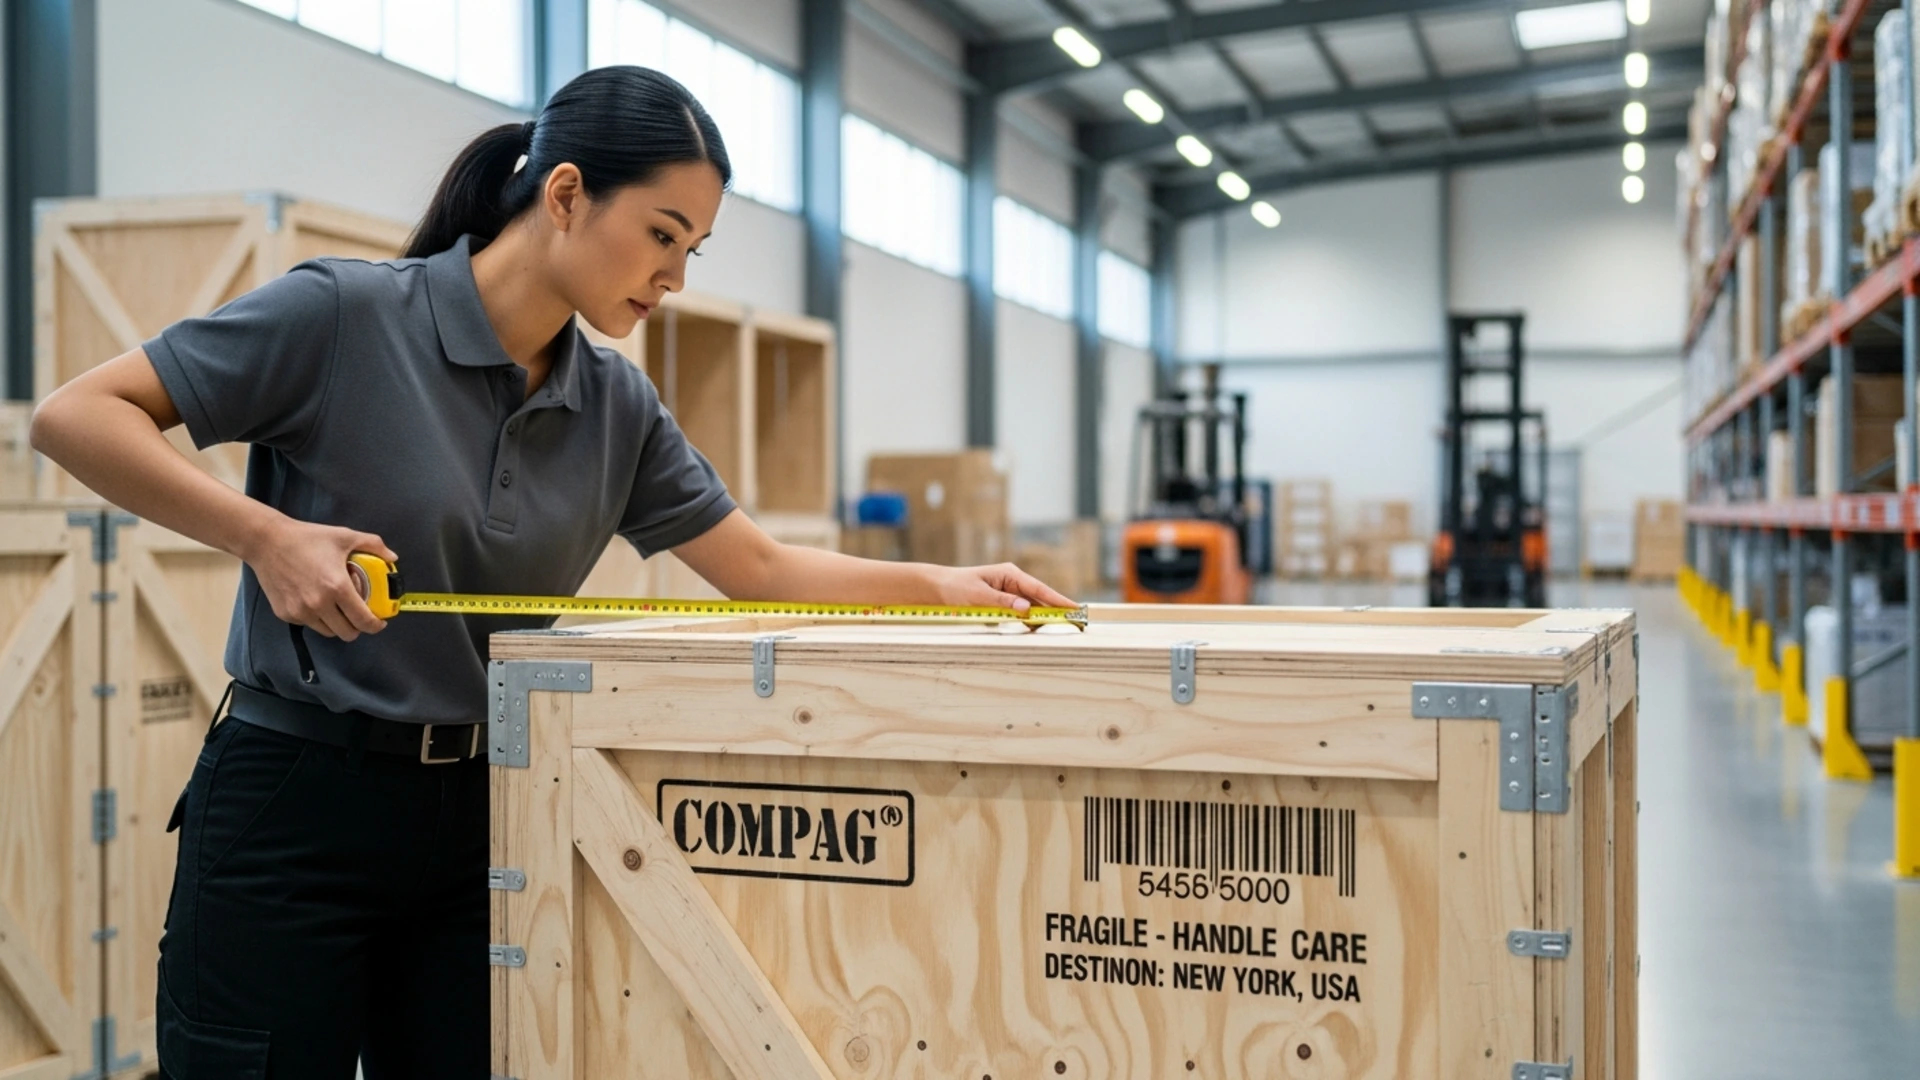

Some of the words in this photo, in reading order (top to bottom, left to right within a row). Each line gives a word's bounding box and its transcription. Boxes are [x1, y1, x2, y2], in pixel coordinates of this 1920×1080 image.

[1045, 912, 1148, 948] FRAGILE
[1173, 921, 1277, 958] HANDLE
[1291, 929, 1368, 965] CARE
[1045, 952, 1165, 988] DESTINON:
[1173, 961, 1226, 993] NEW
[1232, 966, 1303, 1004] YORK,
[1311, 972, 1361, 1003] USA
